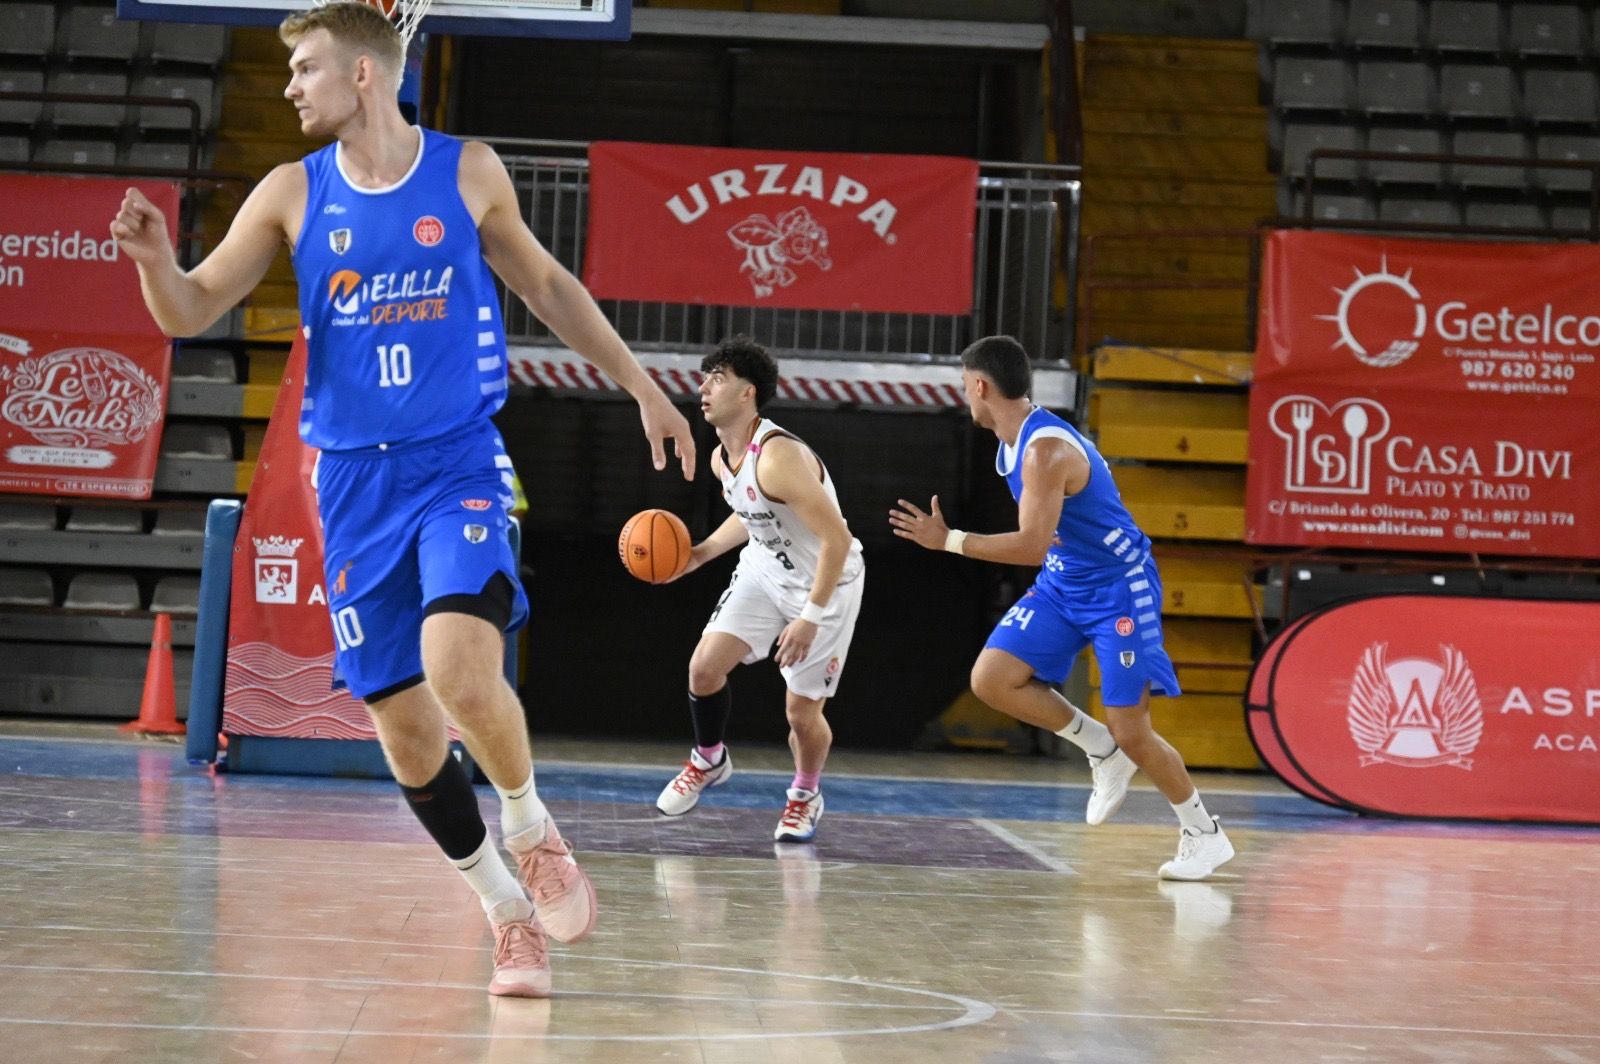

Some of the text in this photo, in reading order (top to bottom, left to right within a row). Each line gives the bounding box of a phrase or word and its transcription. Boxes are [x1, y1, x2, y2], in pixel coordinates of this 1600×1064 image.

[665, 163, 898, 238] URZAPA
[0, 230, 119, 262] ersidad
[371, 298, 449, 325] DEPORTE
[1434, 302, 1600, 347] Getelco
[376, 343, 412, 388] 10
[1460, 360, 1576, 381] 987 620 240
[28, 397, 129, 432] Nails
[1289, 500, 1348, 517] Brianda
[1351, 502, 1368, 518] de
[1430, 506, 1451, 521] 20
[1302, 520, 1444, 538] www.casadivi.com
[330, 605, 366, 652] 10
[1000, 605, 1036, 631] 24
